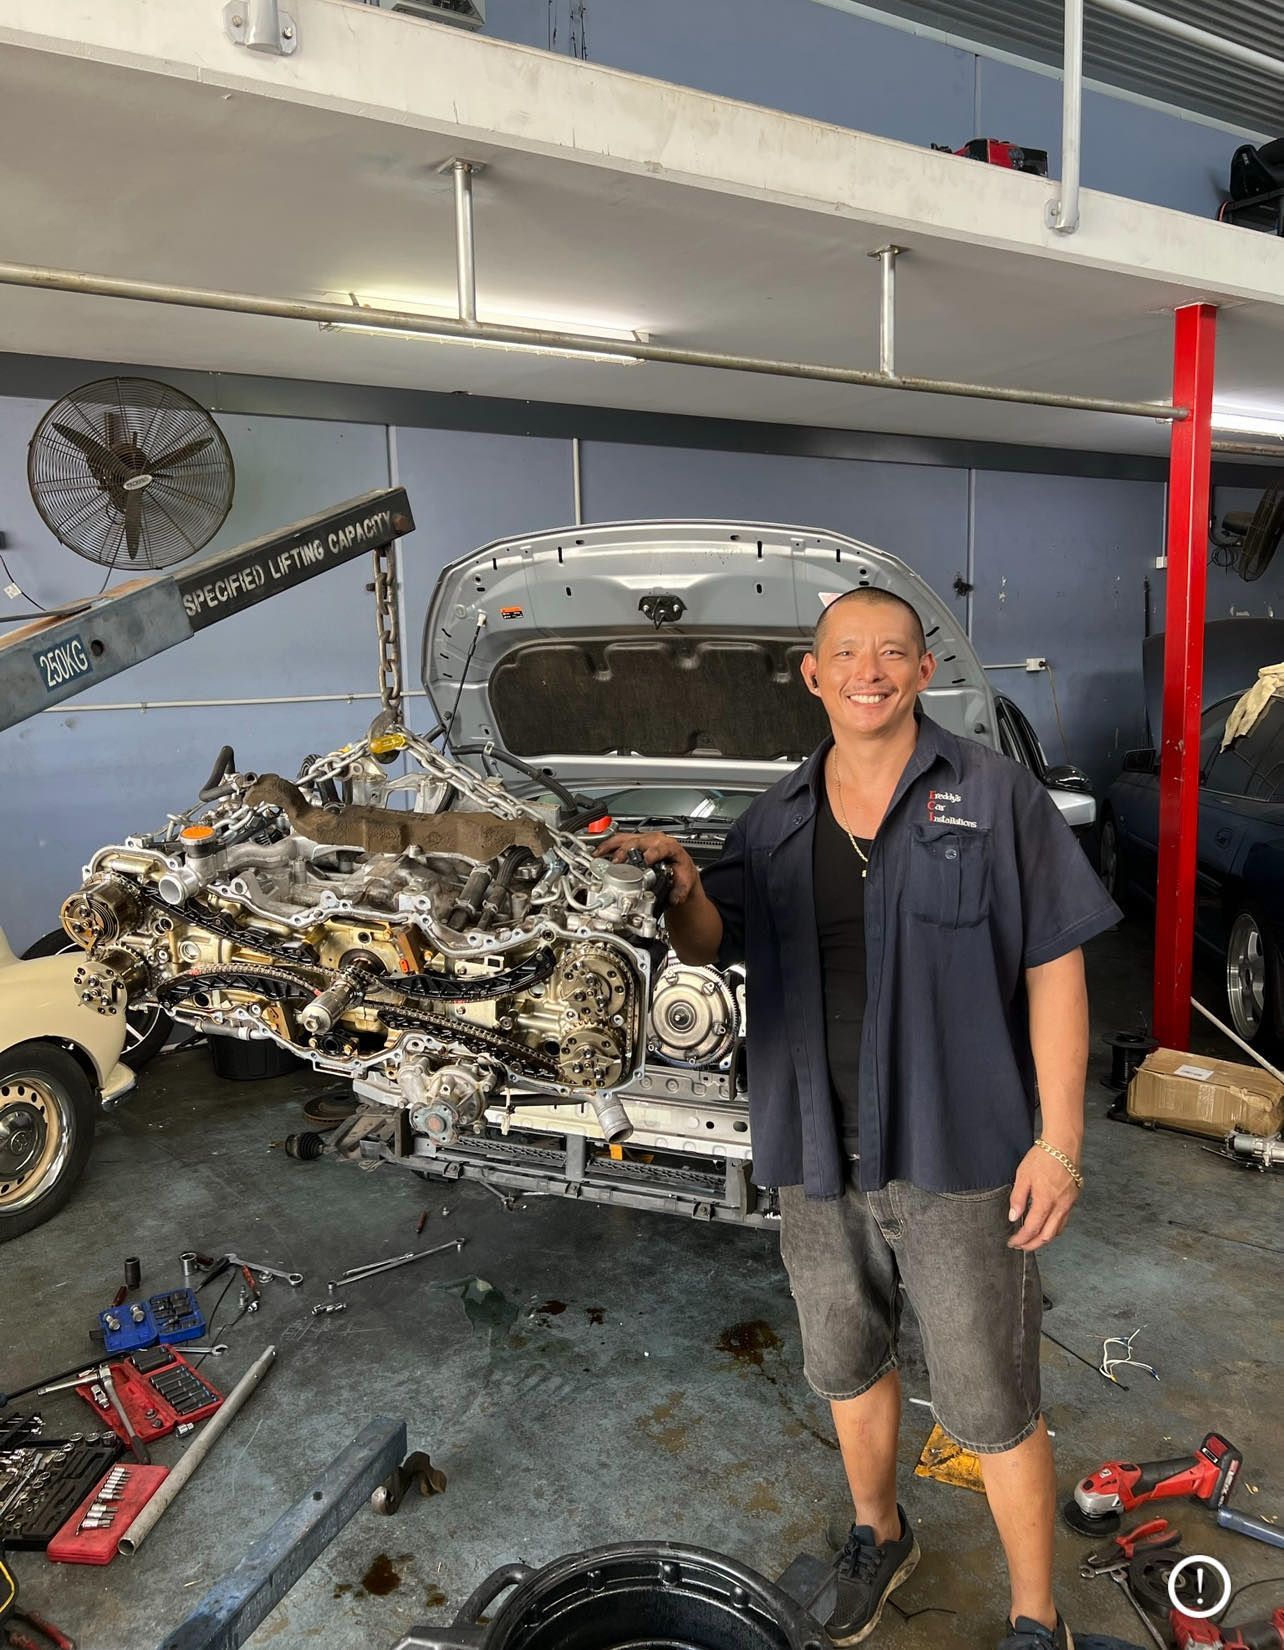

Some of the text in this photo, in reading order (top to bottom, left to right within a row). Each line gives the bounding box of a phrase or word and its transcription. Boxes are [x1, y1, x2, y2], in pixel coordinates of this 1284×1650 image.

[183, 510, 392, 617] SPECIFIED LIFTING CAPACITY
[39, 640, 88, 687] 250KG
[927, 801, 946, 811] Car
[928, 811, 977, 828] Installations
